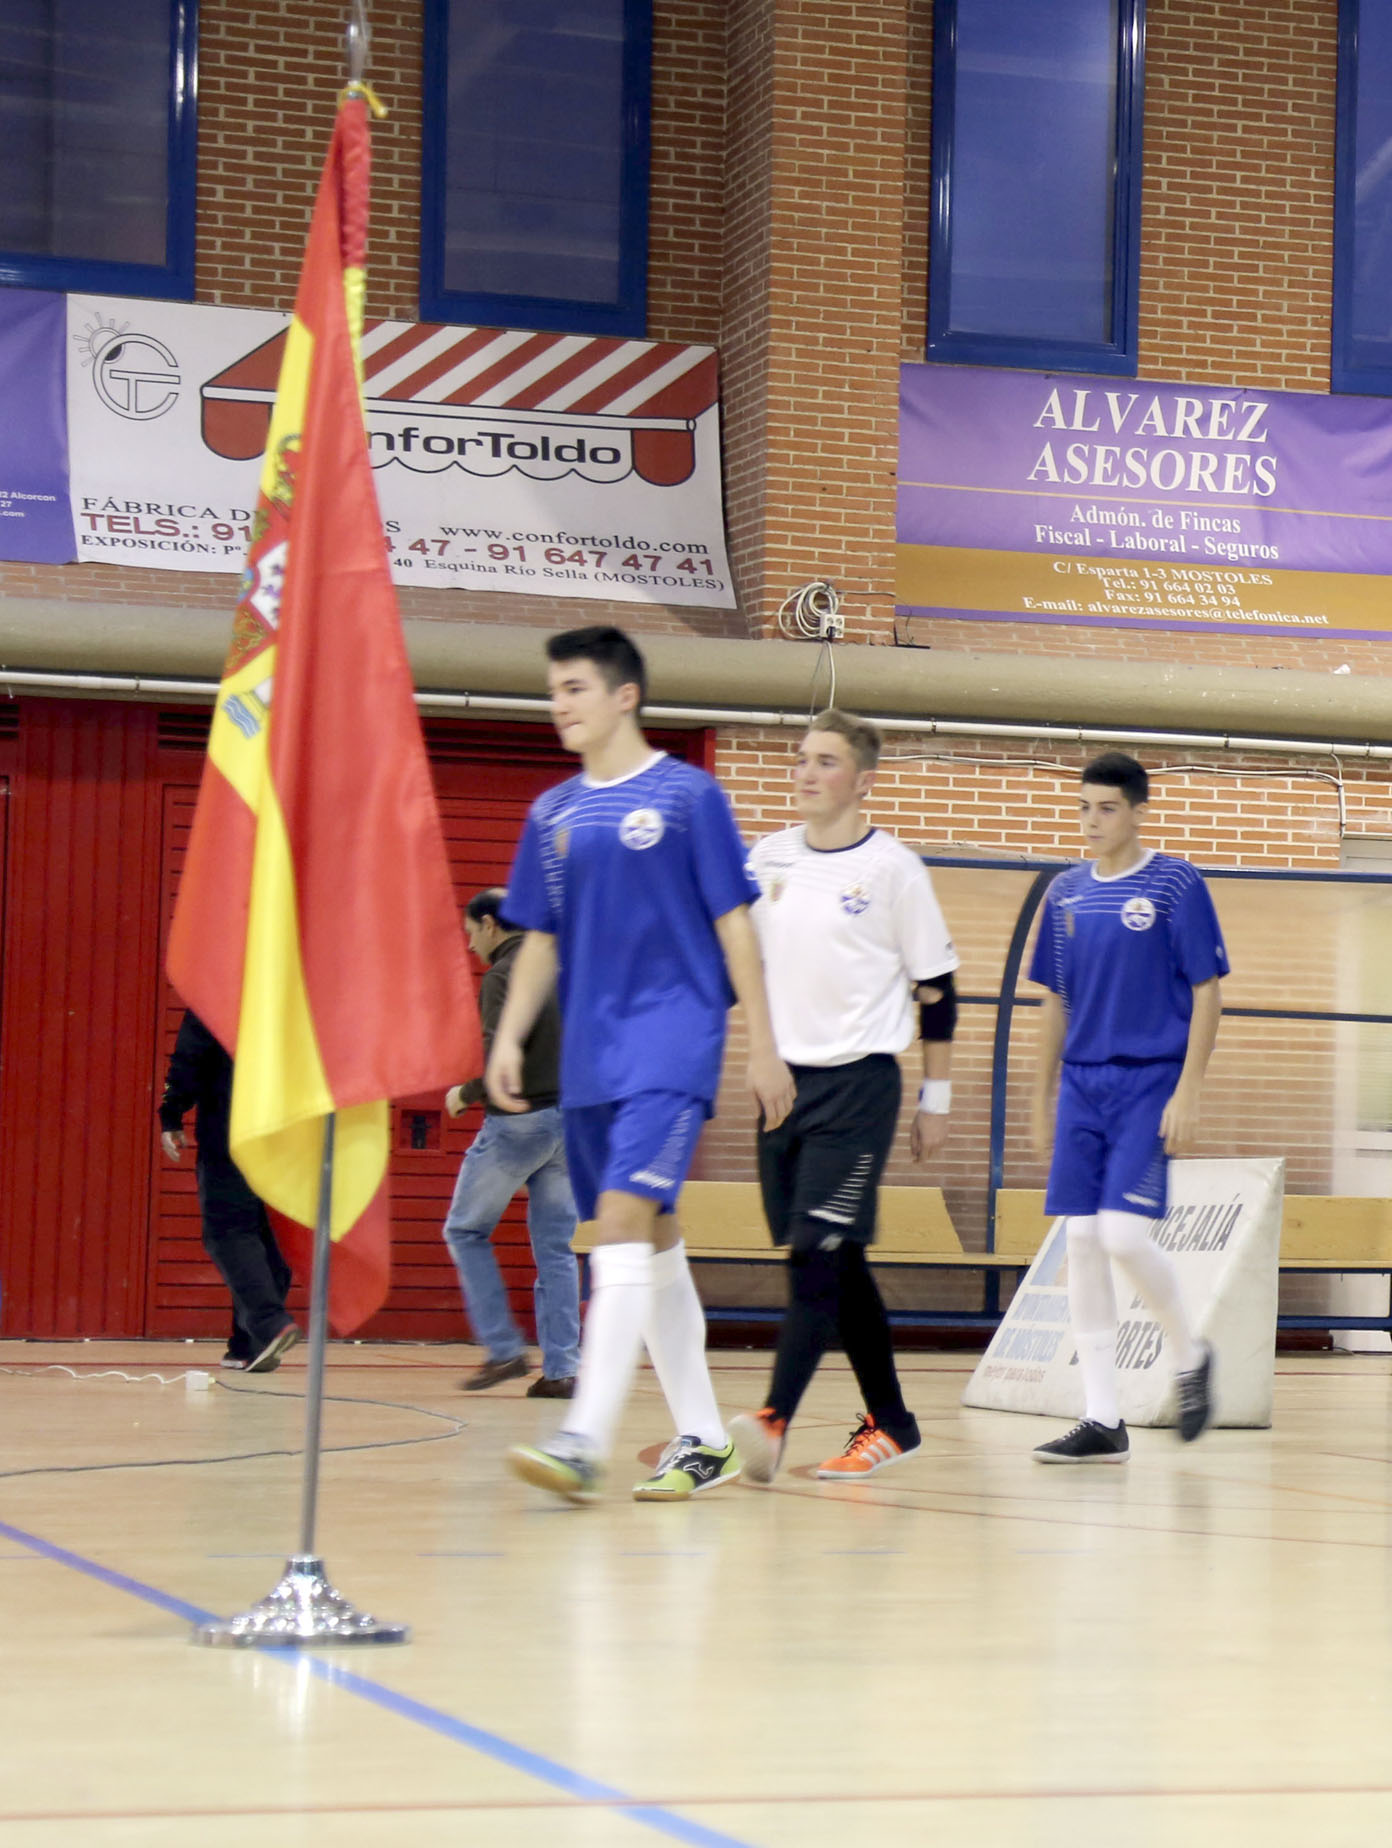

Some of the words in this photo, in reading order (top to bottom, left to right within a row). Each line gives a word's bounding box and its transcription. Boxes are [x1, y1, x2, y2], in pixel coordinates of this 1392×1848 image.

[1033, 387, 1269, 443] ALVAREZ
[367, 427, 621, 465] nforToldo
[1027, 441, 1277, 497] ASESORES
[10, 491, 56, 501] Alcorcon
[82, 496, 219, 520] FÁBRICA
[231, 510, 256, 522] D
[1070, 504, 1146, 528] Admón.
[1152, 509, 1174, 529] de
[1180, 511, 1241, 533] Fincas
[81, 512, 199, 538] TELS.:
[211, 523, 252, 541] 91
[408, 538, 450, 557] 47
[487, 543, 526, 562] 91
[545, 548, 607, 568] 647
[622, 554, 662, 573] 47
[677, 558, 713, 576] 41
[441, 526, 708, 554] www.confortoldo.com
[1034, 524, 1091, 546] Fiscal
[1109, 530, 1186, 553] Laboral
[1204, 536, 1279, 561] Seguros
[82, 534, 216, 554] EXPOSICIÓN:
[425, 559, 497, 574] Esquina
[505, 563, 536, 577] Río
[543, 567, 587, 581] Sella
[594, 571, 725, 591] (MOSTOLES)
[1053, 561, 1072, 575] C/
[1076, 563, 1138, 581] Esparta
[1143, 567, 1167, 579] 1-3
[1171, 569, 1273, 585] MOSTOLES
[1102, 577, 1136, 590] Tel.:
[1139, 579, 1157, 591] 91
[1163, 581, 1191, 593] 664
[1195, 582, 1214, 594] 02
[1218, 584, 1236, 596] 03
[1104, 589, 1141, 603] Fax:
[1144, 591, 1161, 603] 91
[1168, 593, 1194, 605] 664
[1199, 595, 1217, 606] 34
[1222, 596, 1240, 608] 94
[1022, 597, 1083, 612] E-mail:
[1087, 599, 1329, 626] alvarezasesores@telefonica.net
[1147, 1193, 1243, 1251] NCEJALÍA
